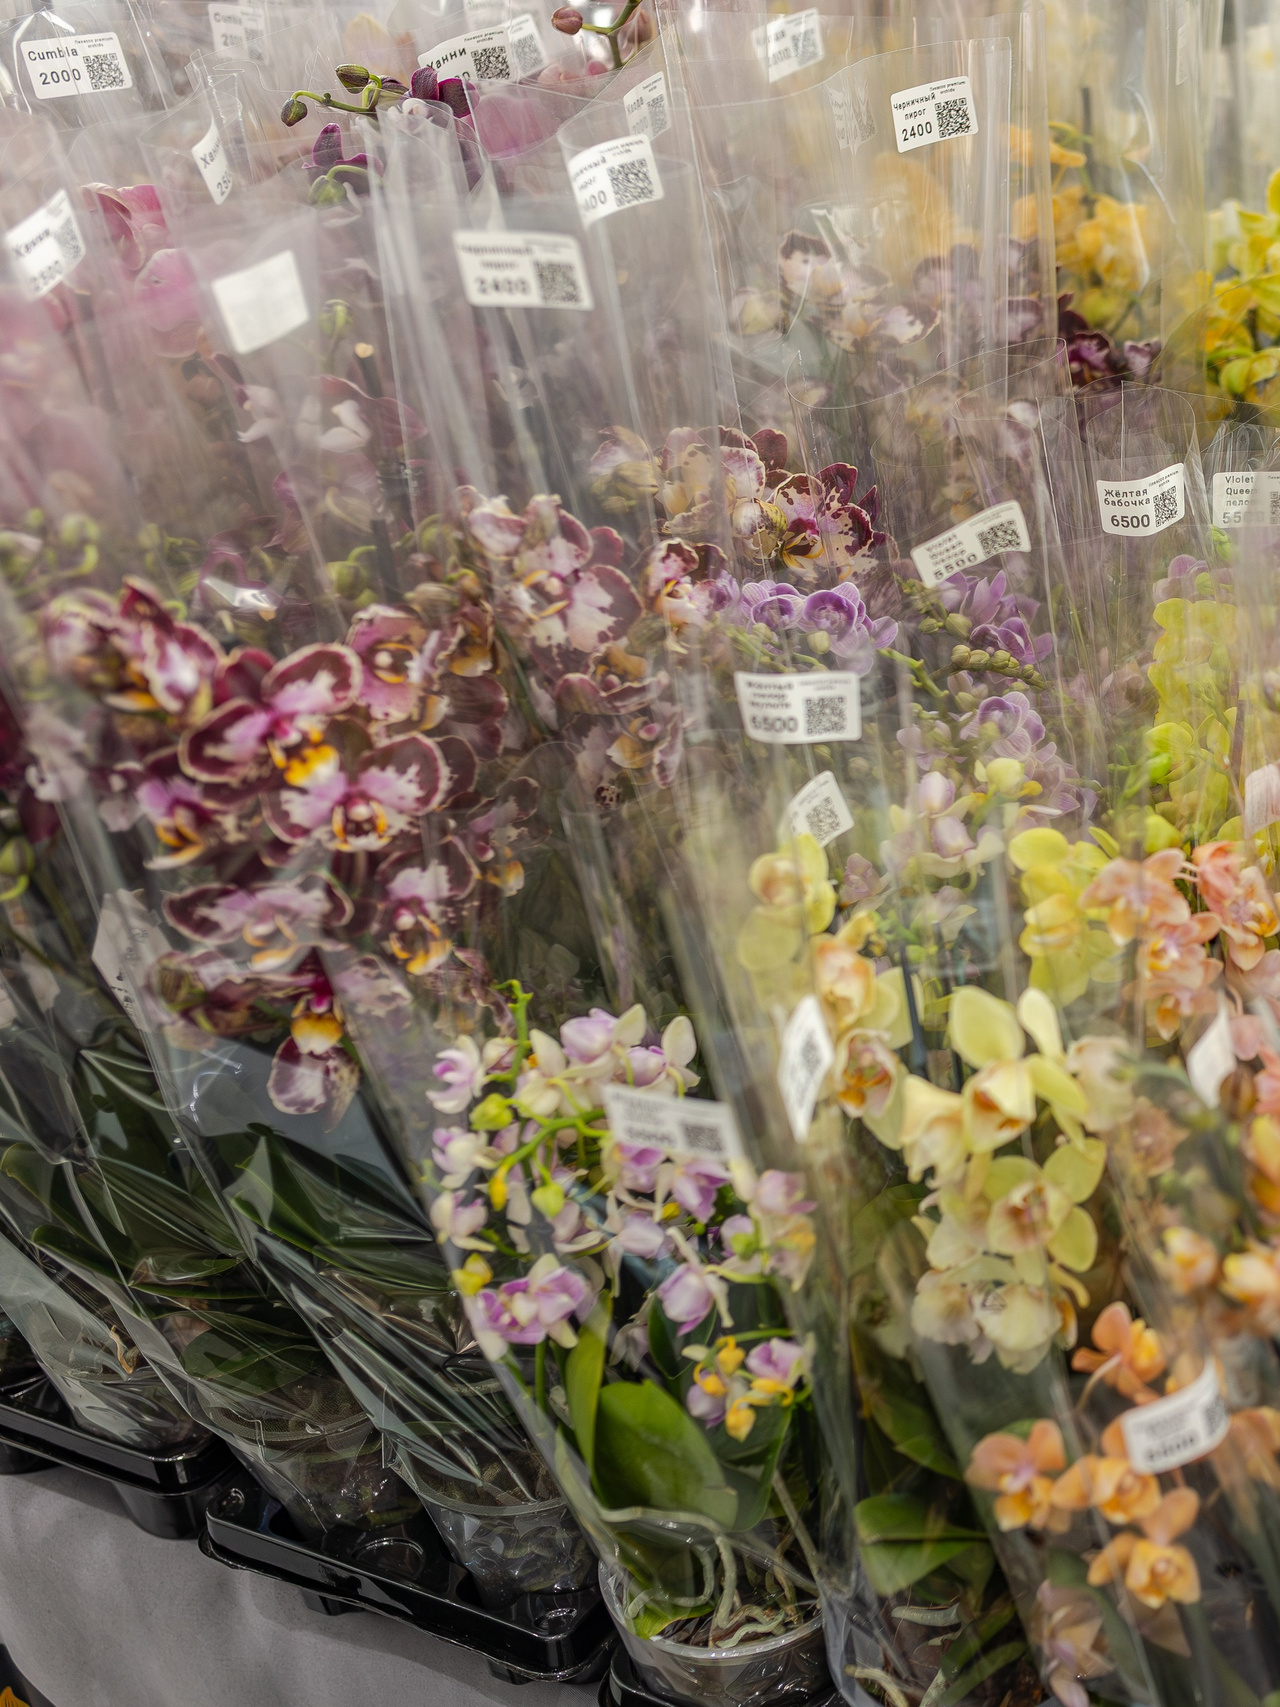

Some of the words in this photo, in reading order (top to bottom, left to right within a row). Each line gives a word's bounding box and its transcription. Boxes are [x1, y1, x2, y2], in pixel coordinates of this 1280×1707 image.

[28, 47, 78, 61] Cumbia
[426, 47, 467, 71] Ханни
[39, 68, 81, 85] 2000
[893, 92, 936, 111] Черничный
[904, 108, 926, 120] пирог
[901, 121, 933, 142] 2400
[1225, 475, 1254, 484] Violet
[1103, 488, 1148, 498] Жёлтая
[1103, 497, 1151, 507] бабочка
[1225, 499, 1253, 507] пело
[1110, 514, 1151, 529] 6500
[934, 553, 978, 580] 5500
